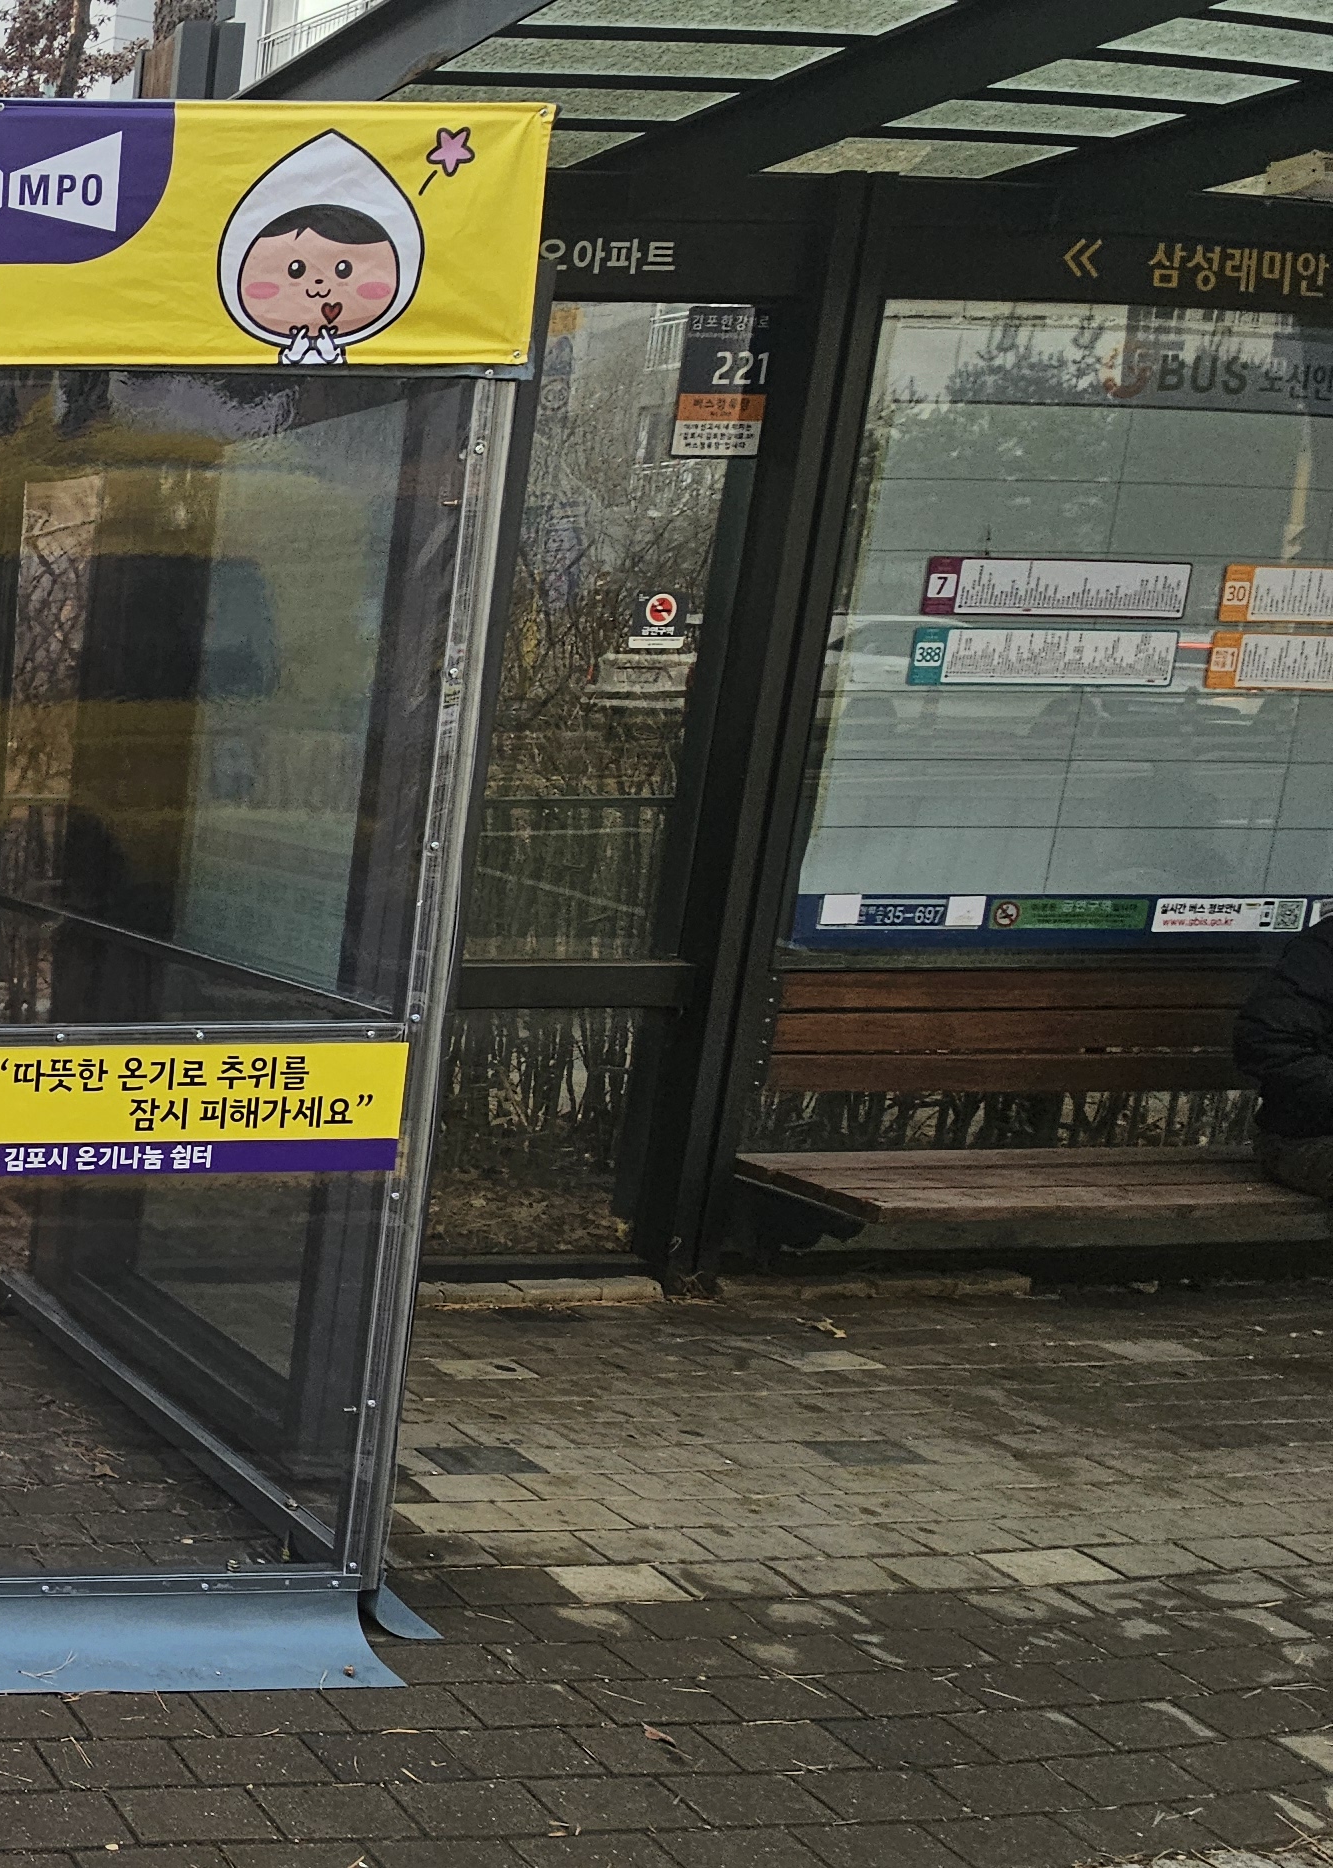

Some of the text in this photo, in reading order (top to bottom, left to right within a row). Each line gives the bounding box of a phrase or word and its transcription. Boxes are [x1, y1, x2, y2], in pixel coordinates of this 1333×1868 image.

[1148, 242, 1330, 298] 삼성래미안
[711, 350, 770, 386] 221
[935, 576, 949, 596] 7
[1226, 585, 1247, 602] 30
[915, 646, 942, 663] 388
[884, 906, 944, 924] 35-697
[1160, 902, 1187, 915] 실시간
[1188, 902, 1206, 914] 버스
[117, 1056, 207, 1092] 온기로
[216, 1054, 310, 1091] 추위를
[129, 1097, 189, 1132] 잠시
[4, 1144, 212, 1172] 김포시 온기나눔 쉼터
